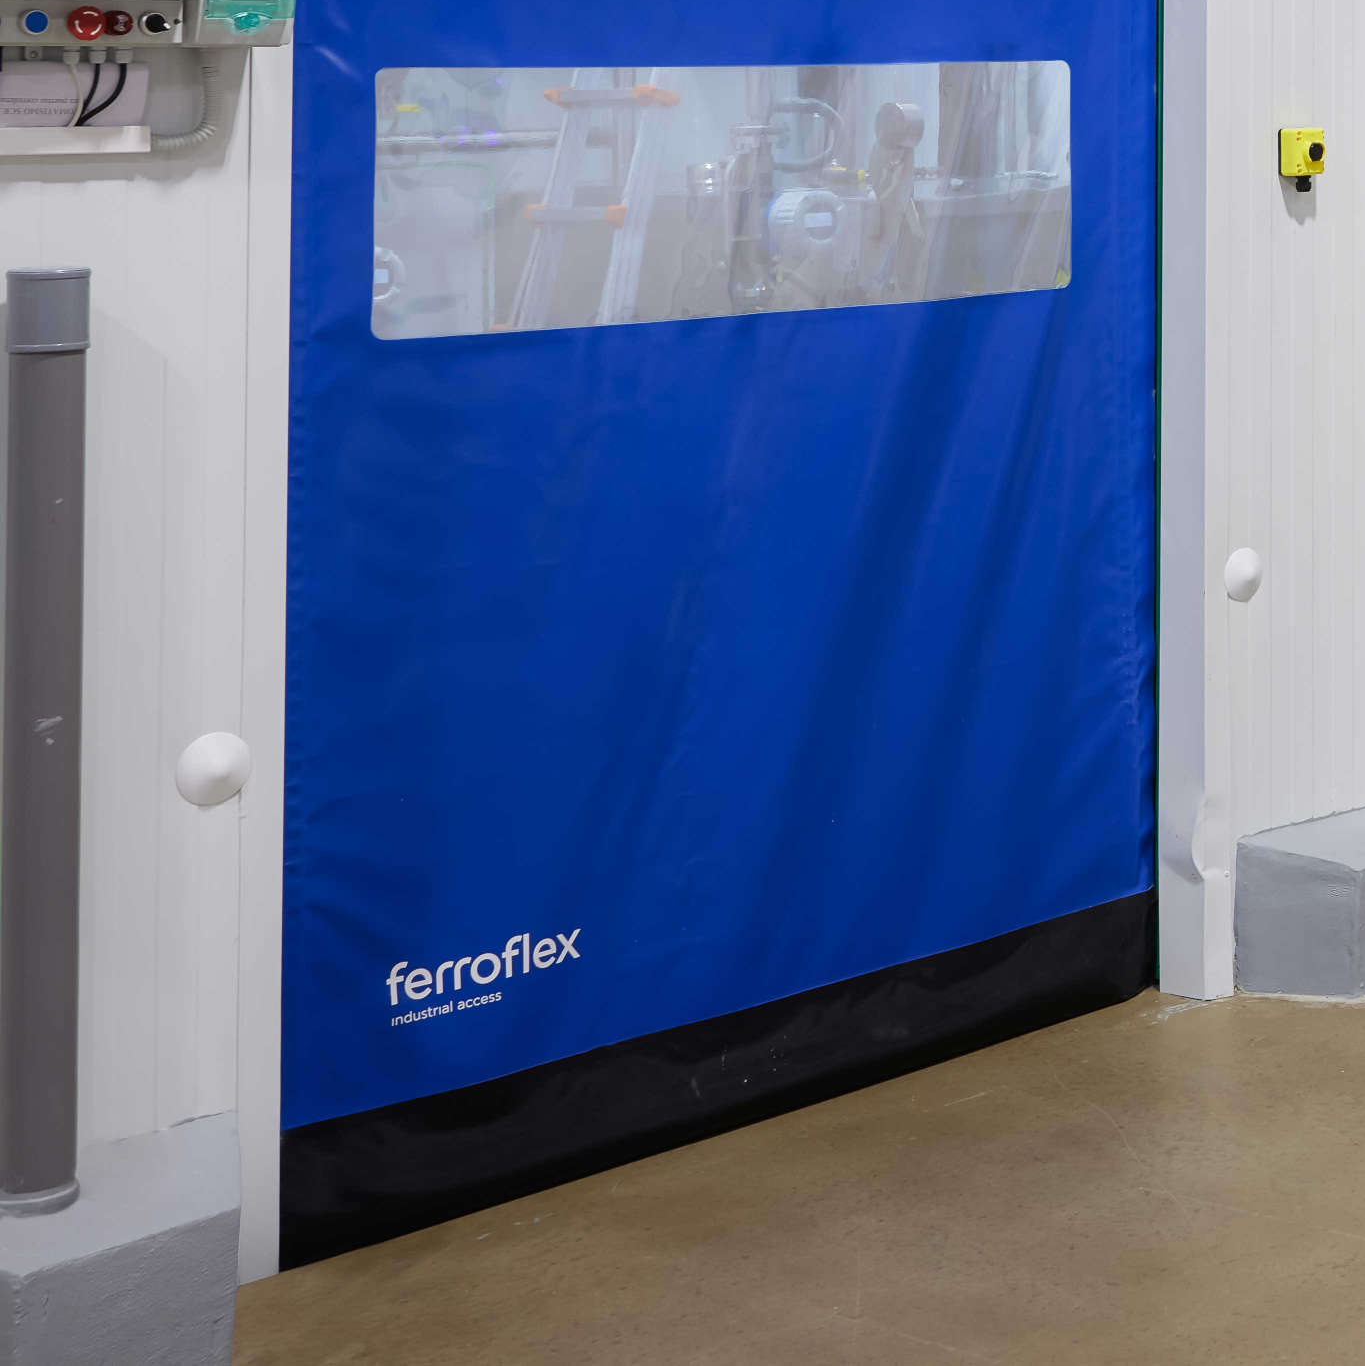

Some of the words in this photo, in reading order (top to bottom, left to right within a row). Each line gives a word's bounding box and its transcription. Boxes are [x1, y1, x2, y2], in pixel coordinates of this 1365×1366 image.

[386, 928, 582, 1006] ferroflex
[391, 1000, 454, 1027] industrial
[456, 991, 503, 1011] access
